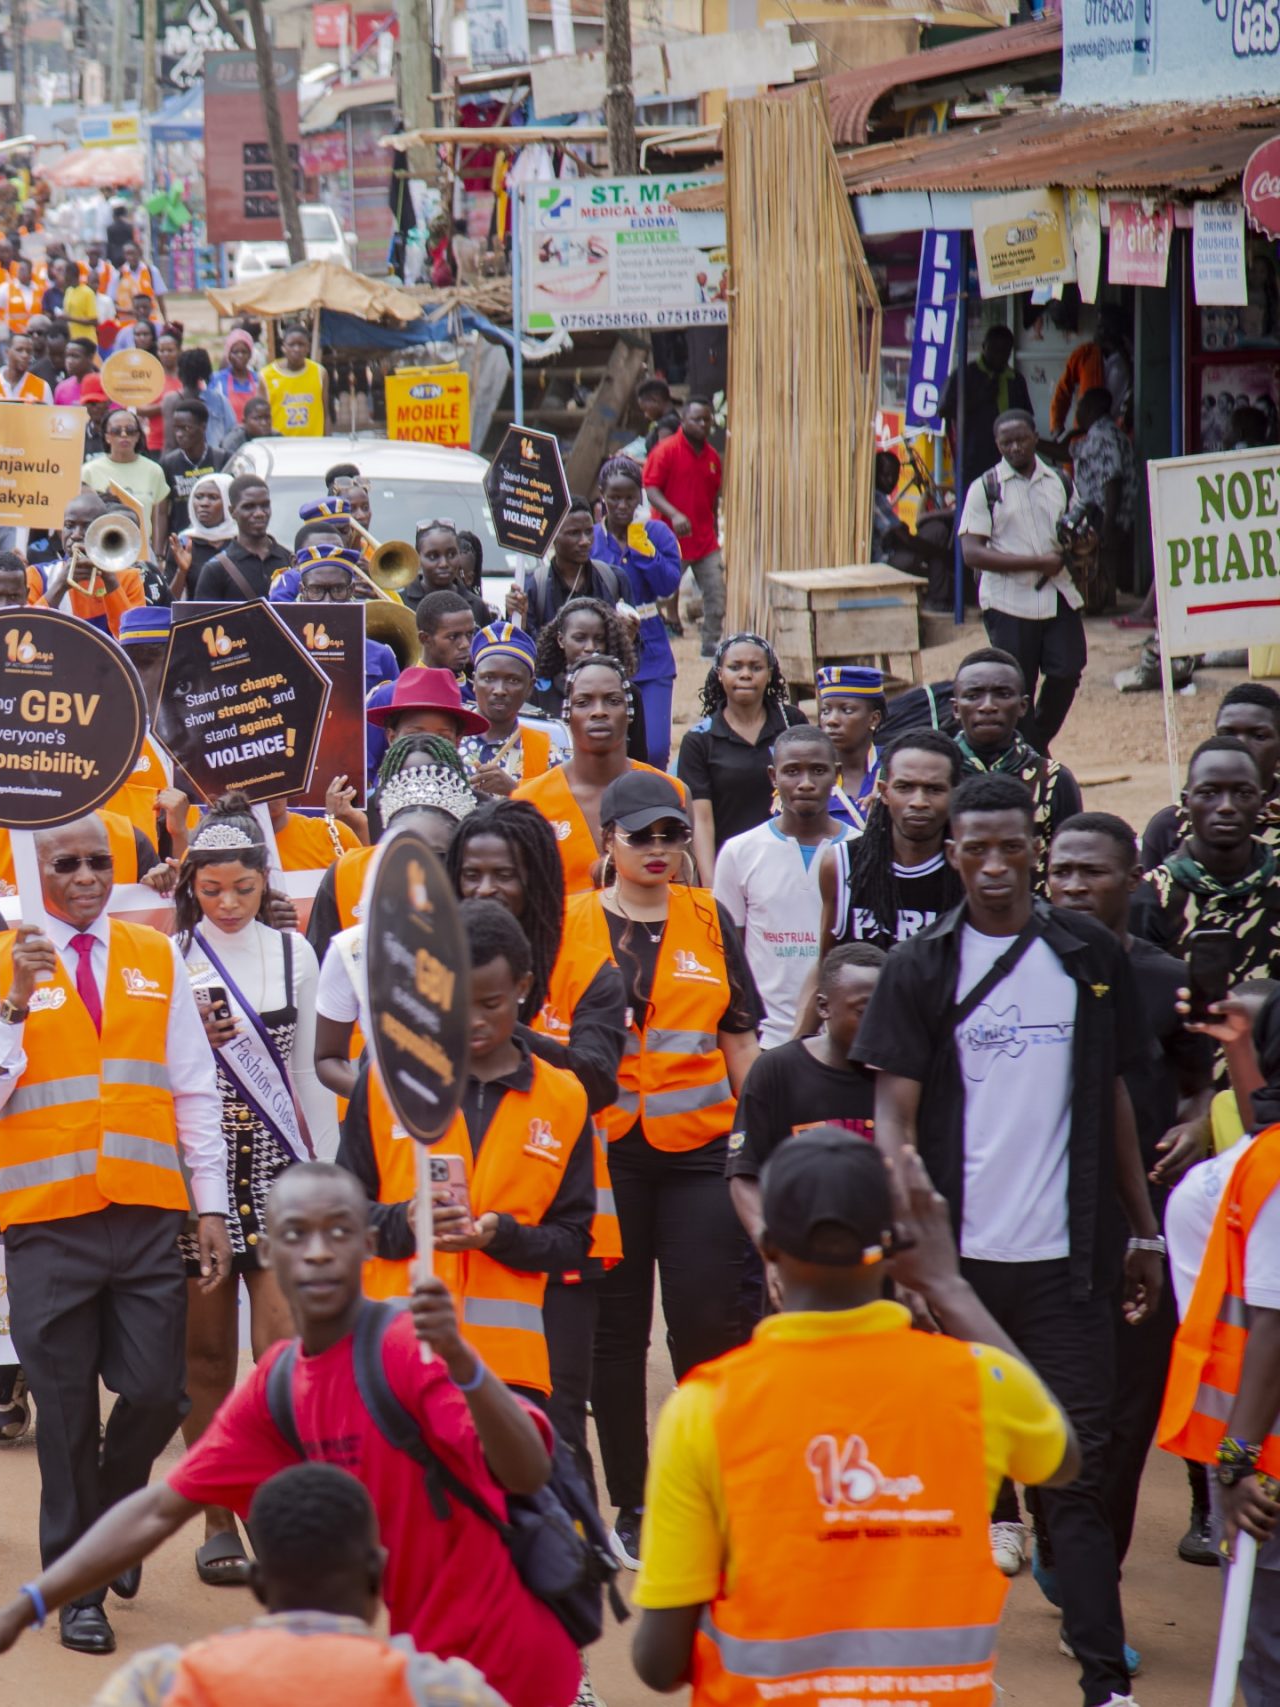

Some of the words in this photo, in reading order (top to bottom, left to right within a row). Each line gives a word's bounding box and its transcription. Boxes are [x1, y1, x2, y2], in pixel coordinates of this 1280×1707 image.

[591, 184, 630, 204] ST.
[581, 205, 637, 218] MEDICAL
[644, 204, 653, 216] &
[1201, 203, 1214, 216] ALL
[1203, 221, 1233, 232] DRINKS
[286, 407, 308, 428] 23
[396, 403, 459, 421] MOBILE
[396, 424, 459, 442] MONEY
[499, 481, 516, 493] show
[542, 494, 554, 505] and
[503, 470, 521, 483] Stand
[520, 476, 530, 486] for
[529, 478, 553, 494] change,
[505, 496, 523, 509] stand
[522, 501, 545, 516] against
[1197, 467, 1280, 524] NOE
[1167, 528, 1280, 588] PHAR
[184, 688, 220, 708] Stand
[221, 684, 238, 698] for
[240, 672, 288, 694] change,
[20, 689, 101, 726] GBV
[184, 711, 215, 728] show
[217, 695, 272, 719] strength,
[272, 687, 296, 705] and
[204, 725, 238, 744] stand
[239, 712, 284, 737] against
[204, 727, 297, 770] VIOLENCE!
[762, 930, 817, 944] MENSTRUAL
[229, 1036, 273, 1099] Fashion
